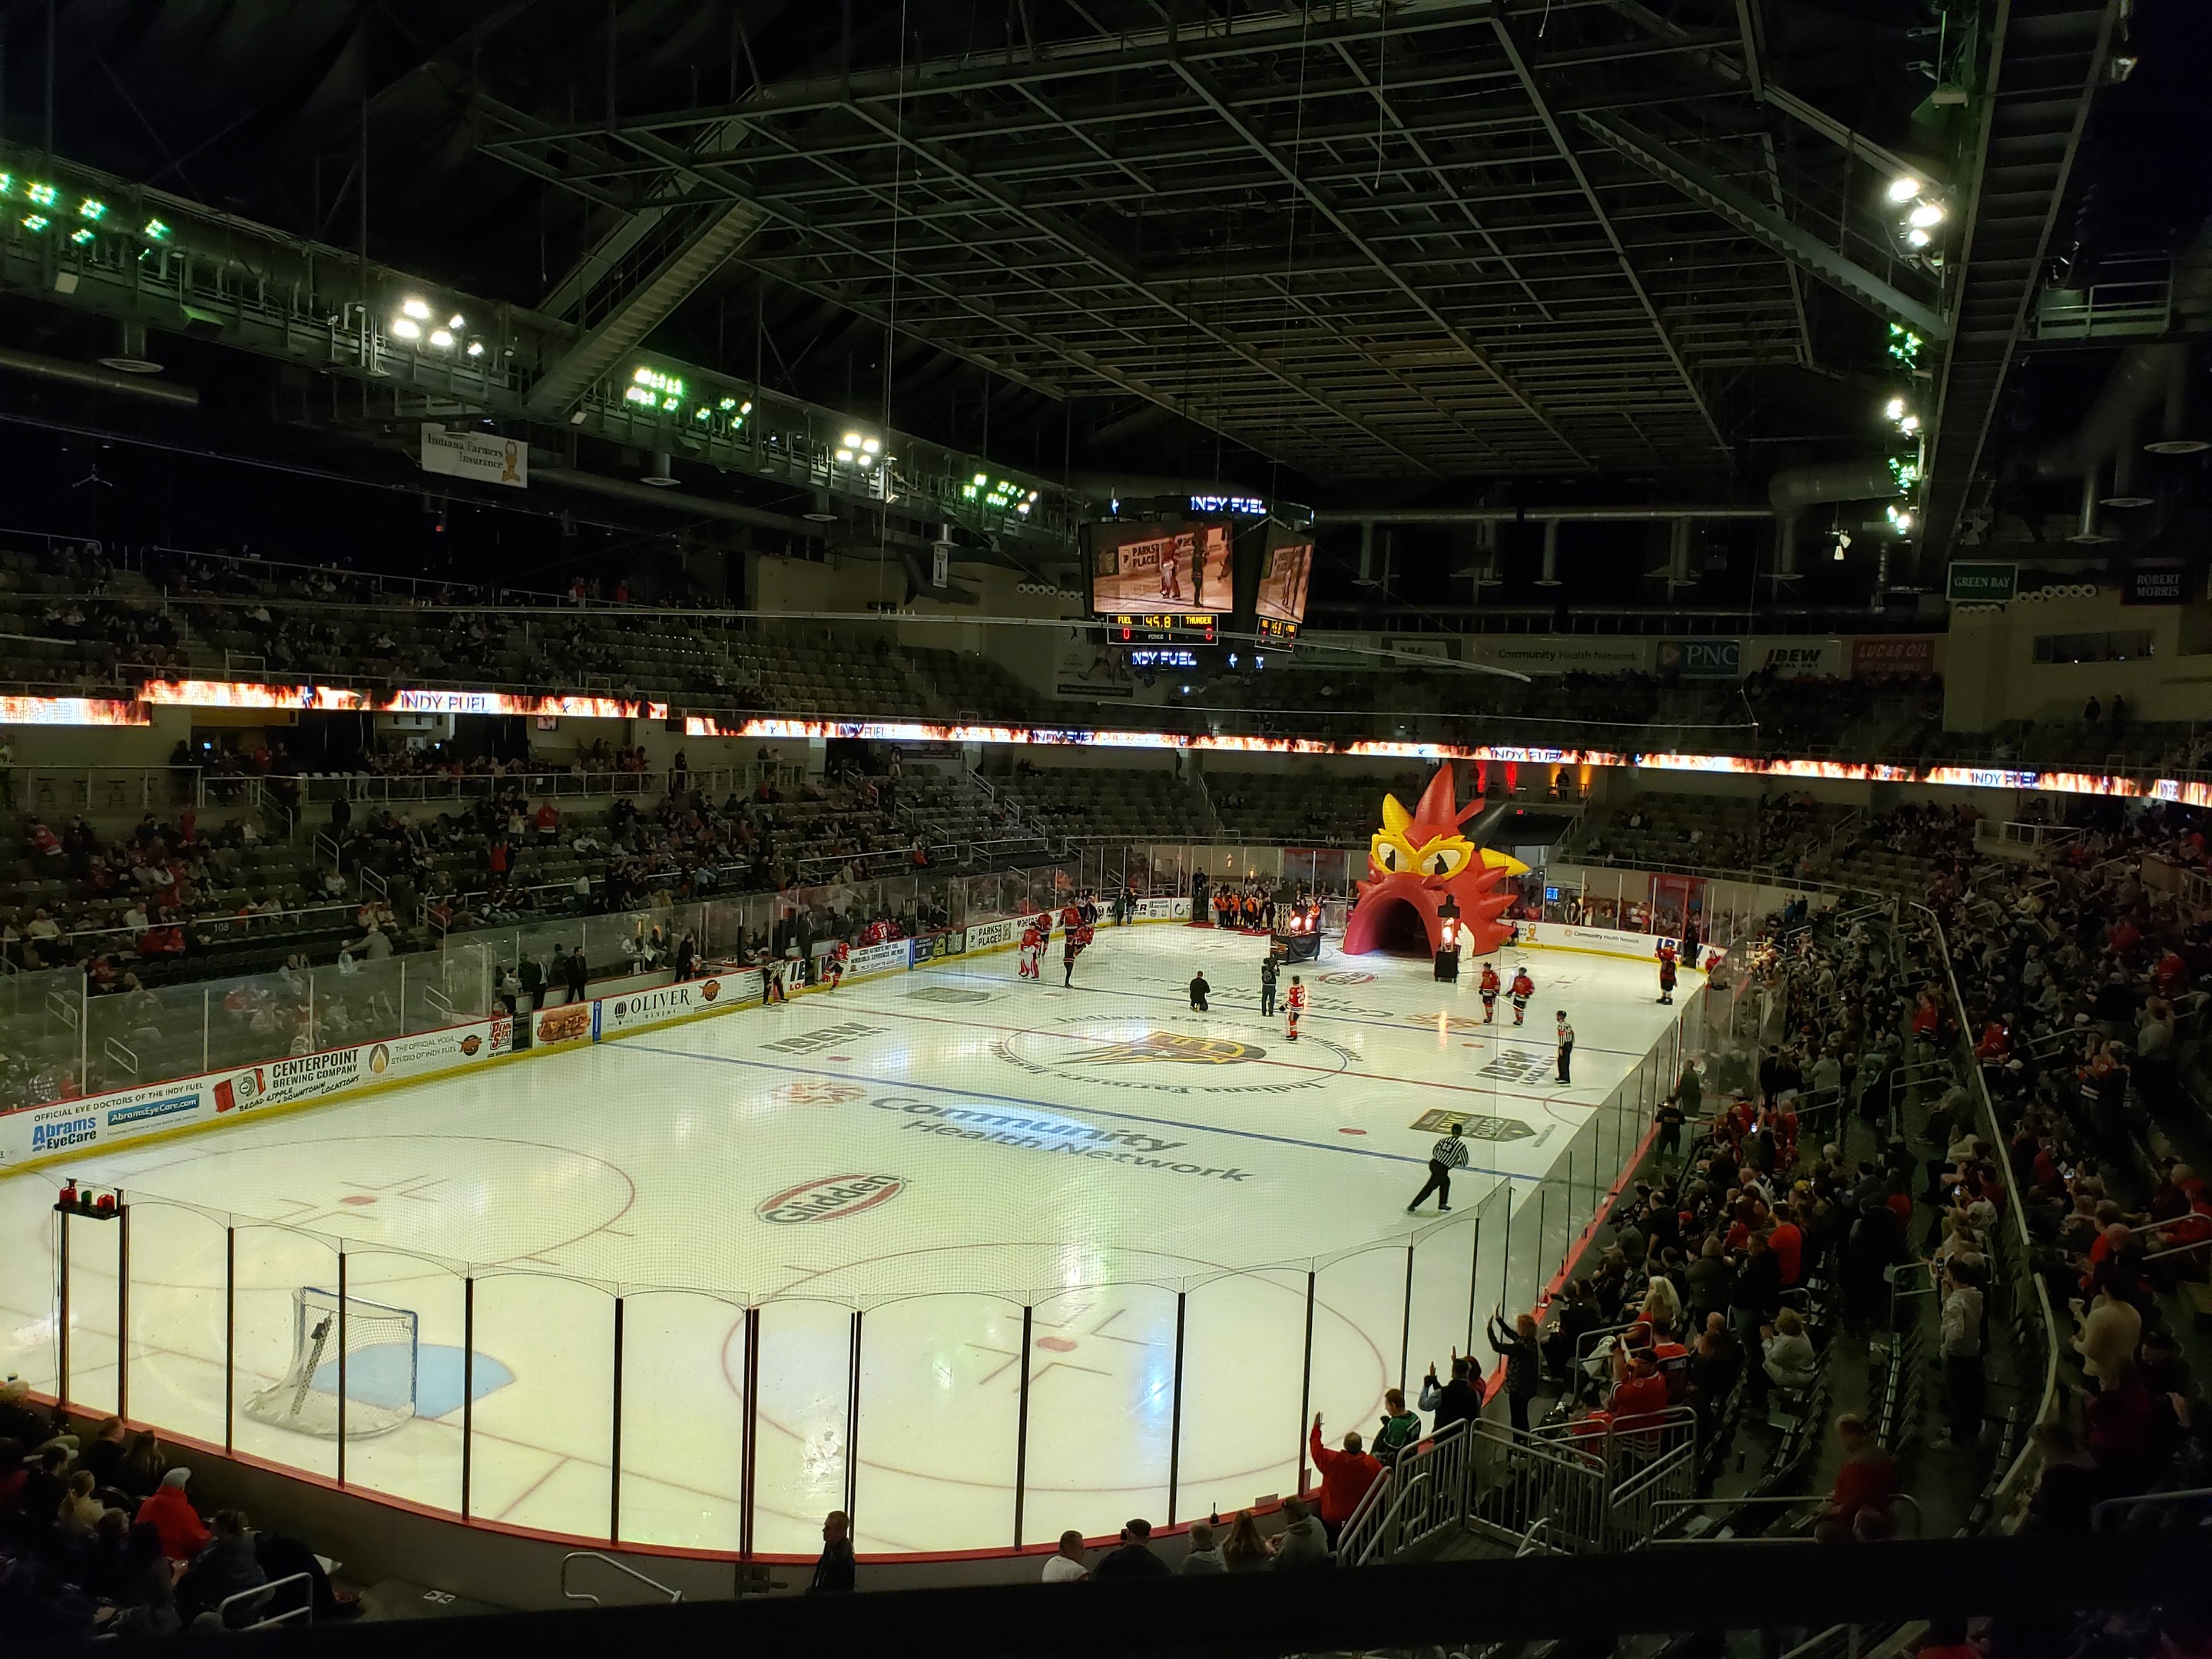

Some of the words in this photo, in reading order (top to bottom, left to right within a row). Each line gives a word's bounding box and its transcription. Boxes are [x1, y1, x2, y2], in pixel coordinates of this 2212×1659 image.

[428, 433, 464, 451] Indiana
[467, 441, 503, 459] Farmers
[459, 452, 503, 469] Insurance
[1190, 495, 1228, 512] INDY
[1230, 497, 1267, 515] FUEL
[1954, 576, 1988, 588] GREEN
[1991, 577, 2011, 588] BAY
[2137, 574, 2181, 585] ROBERT
[2137, 585, 2180, 597] MORRIS
[1118, 616, 1133, 625] FUEL
[1185, 616, 1212, 625] THUNDER
[1132, 651, 1156, 665] INDY
[1160, 651, 1197, 666] FUEL
[1498, 649, 1556, 661] Community
[1559, 650, 1591, 661] Health
[1594, 651, 1637, 661] Network
[1686, 644, 1740, 666] PNC
[1767, 648, 1822, 663] IBEW
[1859, 643, 1903, 659] LUCAS
[1906, 643, 1928, 658] OIL
[401, 690, 442, 710] INDY
[449, 695, 491, 713] FUEL
[839, 724, 863, 737] INDY
[864, 727, 886, 738] FUEL
[1032, 730, 1064, 743] INDY
[1490, 747, 1525, 760] INDY
[1528, 749, 1565, 763] FUEL
[1971, 773, 2002, 786] INDY
[2005, 772, 2040, 788] FUEL
[214, 923, 229, 932] 108
[979, 926, 998, 936] PARKS
[1574, 931, 1603, 940] Community
[979, 935, 998, 945] PLACE
[631, 988, 690, 1015] OLIVER
[395, 1044, 407, 1052] THE
[409, 1039, 435, 1051] OFFICIAL
[437, 1035, 455, 1047] YOGA
[273, 1049, 359, 1078] CENTERPOINT
[391, 1054, 416, 1065] STUDIO
[416, 1051, 426, 1060] OF
[426, 1049, 439, 1058] INDY
[442, 1046, 456, 1056] FUEL
[1475, 1049, 1543, 1083] IBEW
[273, 1073, 313, 1089] BREWING
[316, 1064, 358, 1080] COMPANY
[321, 1075, 360, 1095] LOCATIONS
[239, 1098, 264, 1112] BROAD
[267, 1087, 293, 1101] RIPPLE
[283, 1081, 326, 1102] DOWNTOWN
[34, 1108, 73, 1122] OFFICIAL
[75, 1104, 91, 1114] EYE
[93, 1096, 133, 1111] DOCTORS
[135, 1093, 147, 1102] OF
[147, 1089, 162, 1099] THE
[165, 1085, 184, 1097] INDY
[185, 1082, 204, 1093] FUEL
[111, 1098, 197, 1122] AbramsEyeCare.com
[32, 1117, 98, 1146] Abrams
[869, 1097, 1187, 1152] Community
[46, 1130, 98, 1150] EyeCare
[901, 1119, 1040, 1152] Health
[1051, 1141, 1256, 1183] Network
[766, 1174, 898, 1224] Glidden
